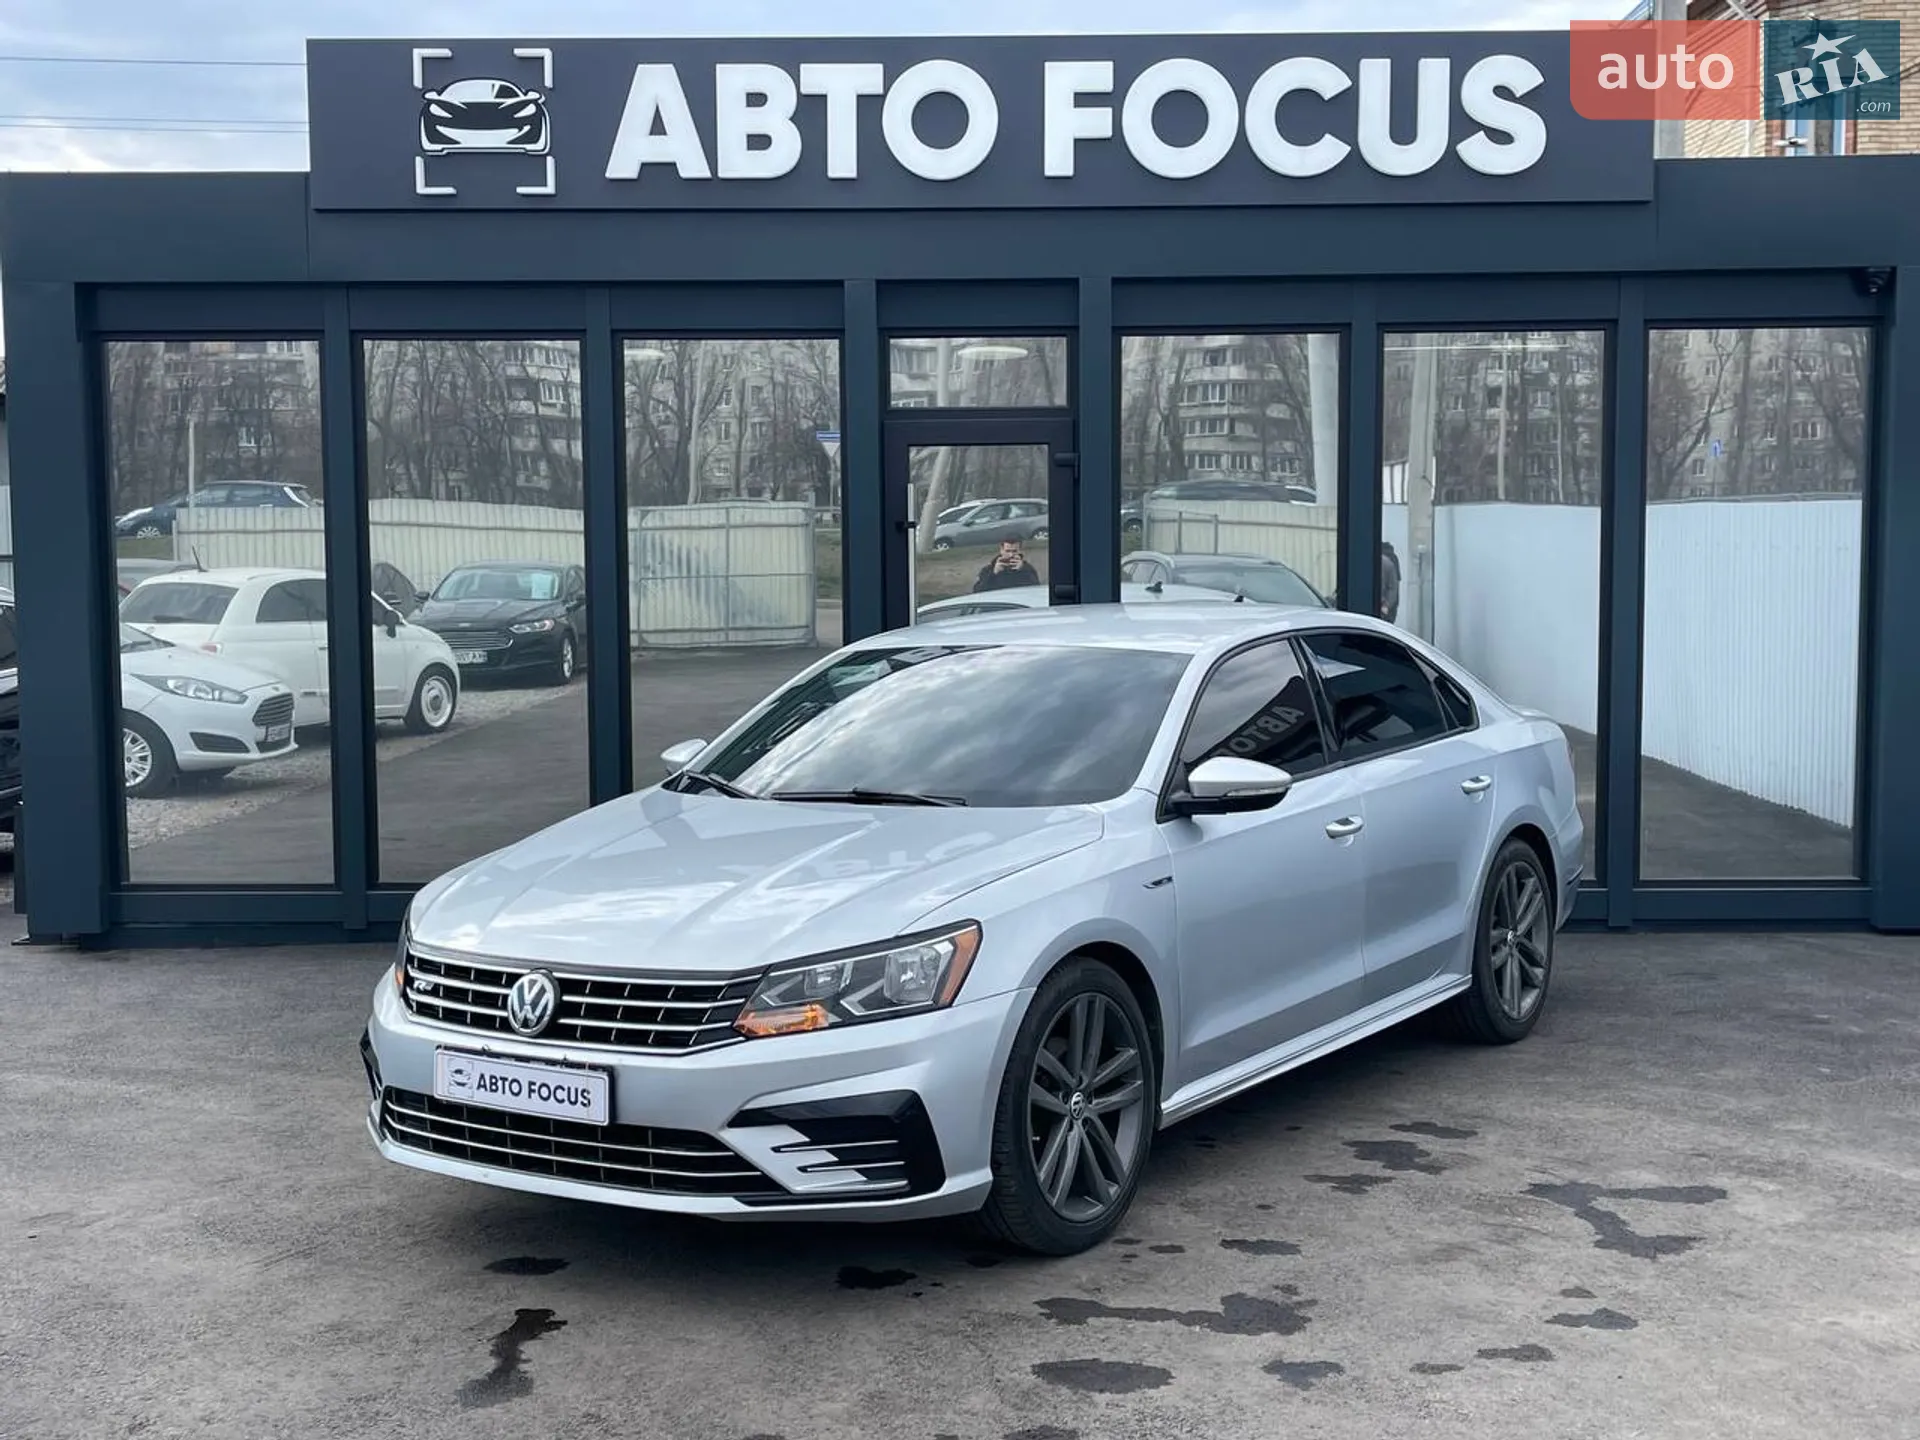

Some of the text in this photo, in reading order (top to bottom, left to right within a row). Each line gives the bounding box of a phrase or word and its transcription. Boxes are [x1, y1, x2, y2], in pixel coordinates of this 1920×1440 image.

[604, 54, 1547, 181] АВТО FOCUS
[476, 1073, 591, 1108] АВТО FOCUS
